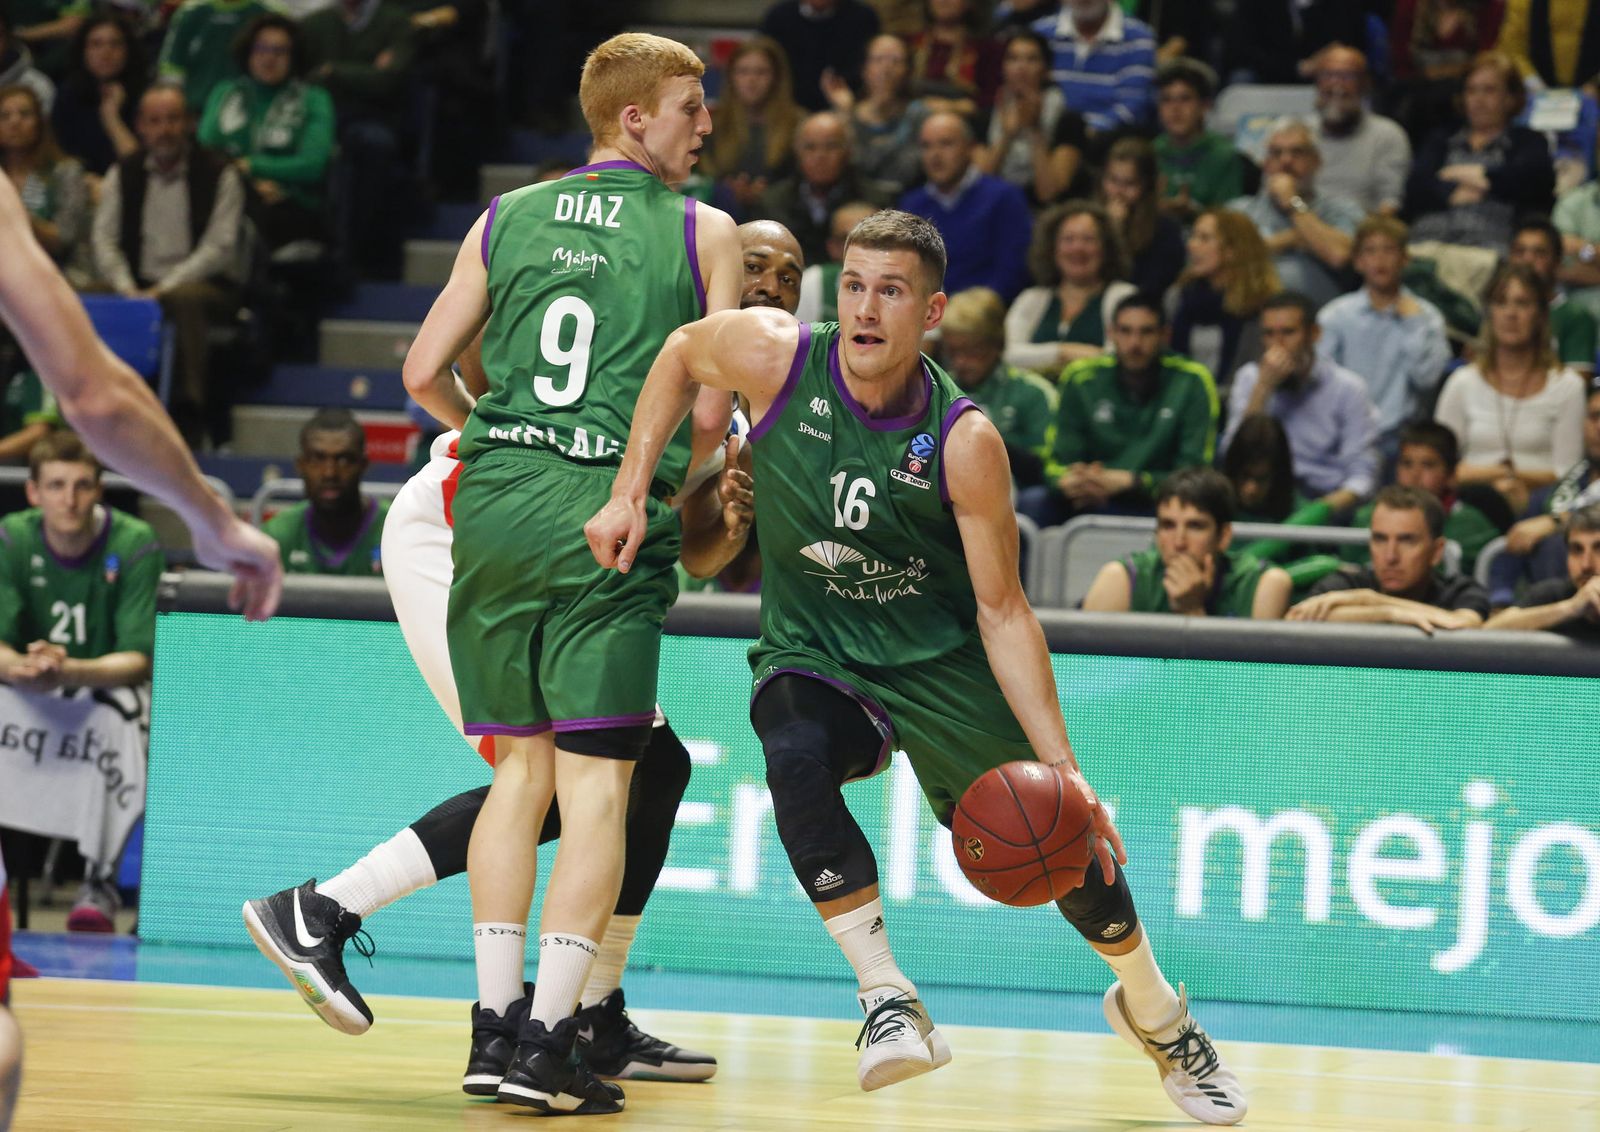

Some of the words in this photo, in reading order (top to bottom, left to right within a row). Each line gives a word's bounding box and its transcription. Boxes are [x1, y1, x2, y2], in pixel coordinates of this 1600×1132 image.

[554, 190, 624, 228] DÍAZ
[552, 246, 608, 279] Málaga
[533, 295, 596, 407] 9
[829, 471, 876, 531] 16
[823, 577, 923, 605] Andalucía
[48, 600, 87, 645] 21
[813, 873, 843, 887] adidas
